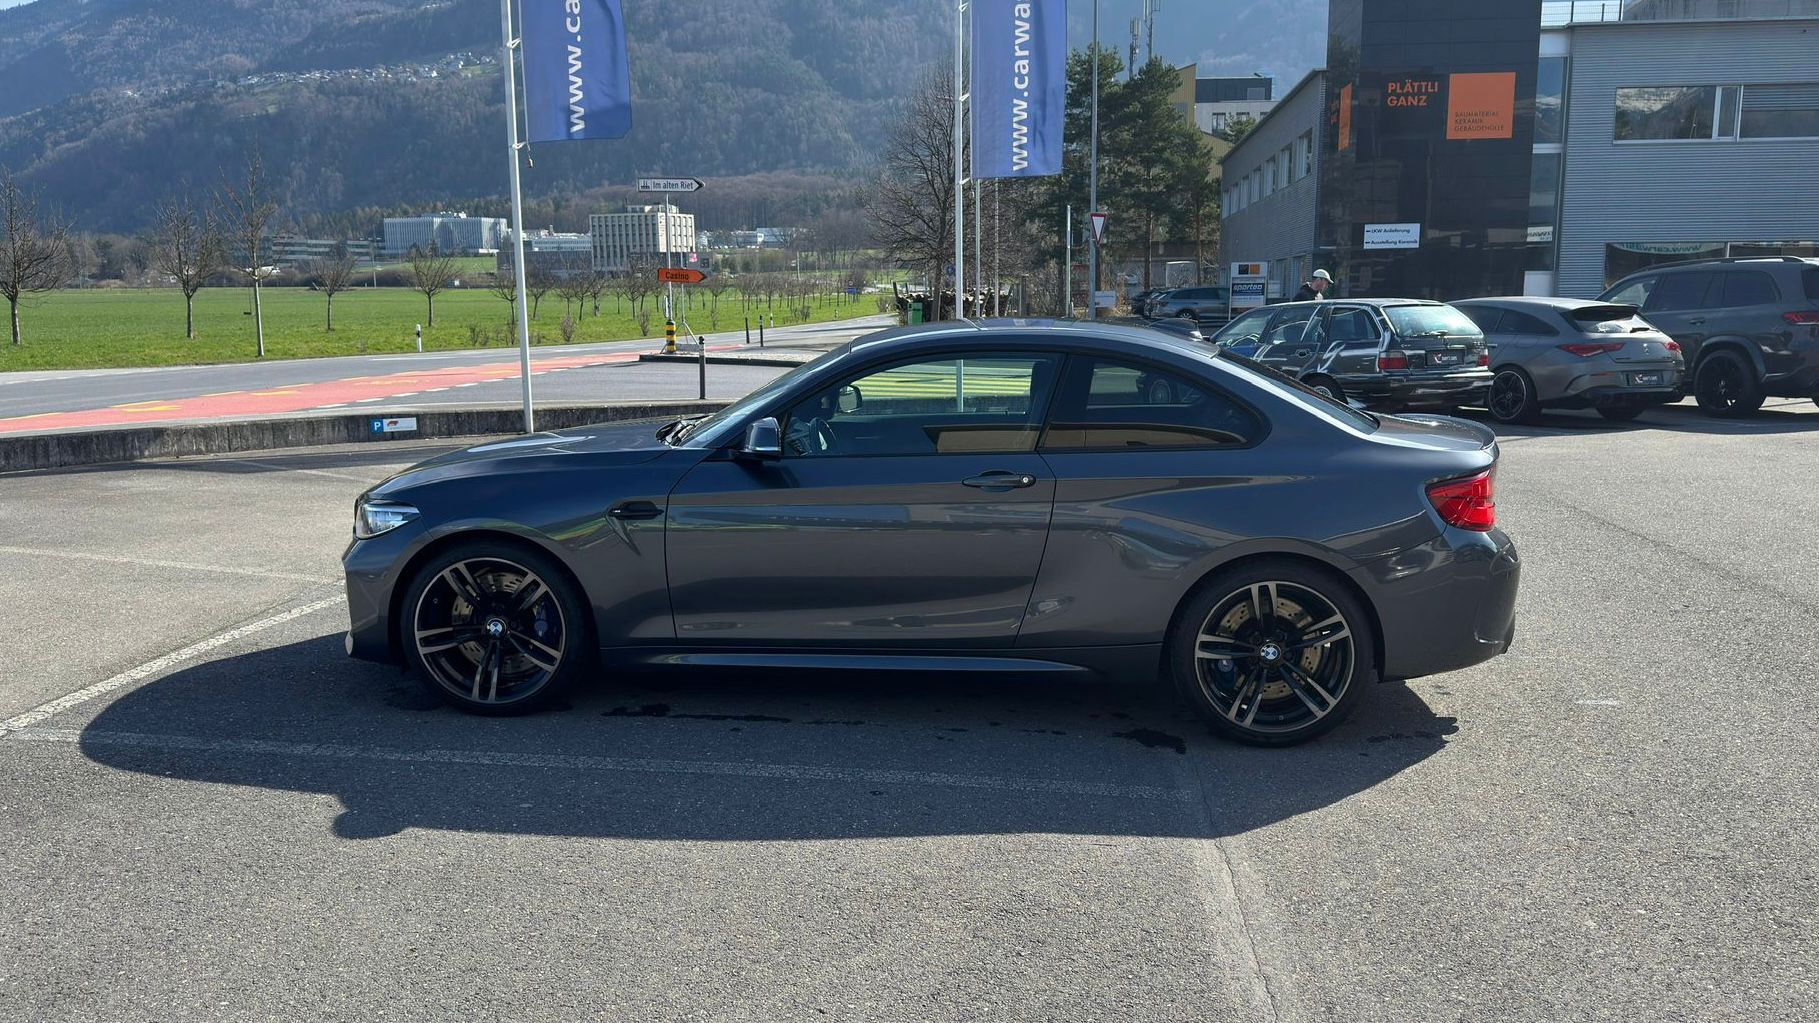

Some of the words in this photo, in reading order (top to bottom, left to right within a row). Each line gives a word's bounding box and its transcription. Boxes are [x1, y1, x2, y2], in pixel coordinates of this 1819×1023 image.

[1012, 0, 1031, 172] www.carwa
[1387, 79, 1439, 94] PLÄTTLI
[1387, 95, 1428, 107] GANZ
[653, 181, 662, 189] Im
[662, 180, 679, 190] alten
[680, 180, 694, 190] Riet
[665, 272, 689, 281] Casino
[374, 421, 381, 431] P
